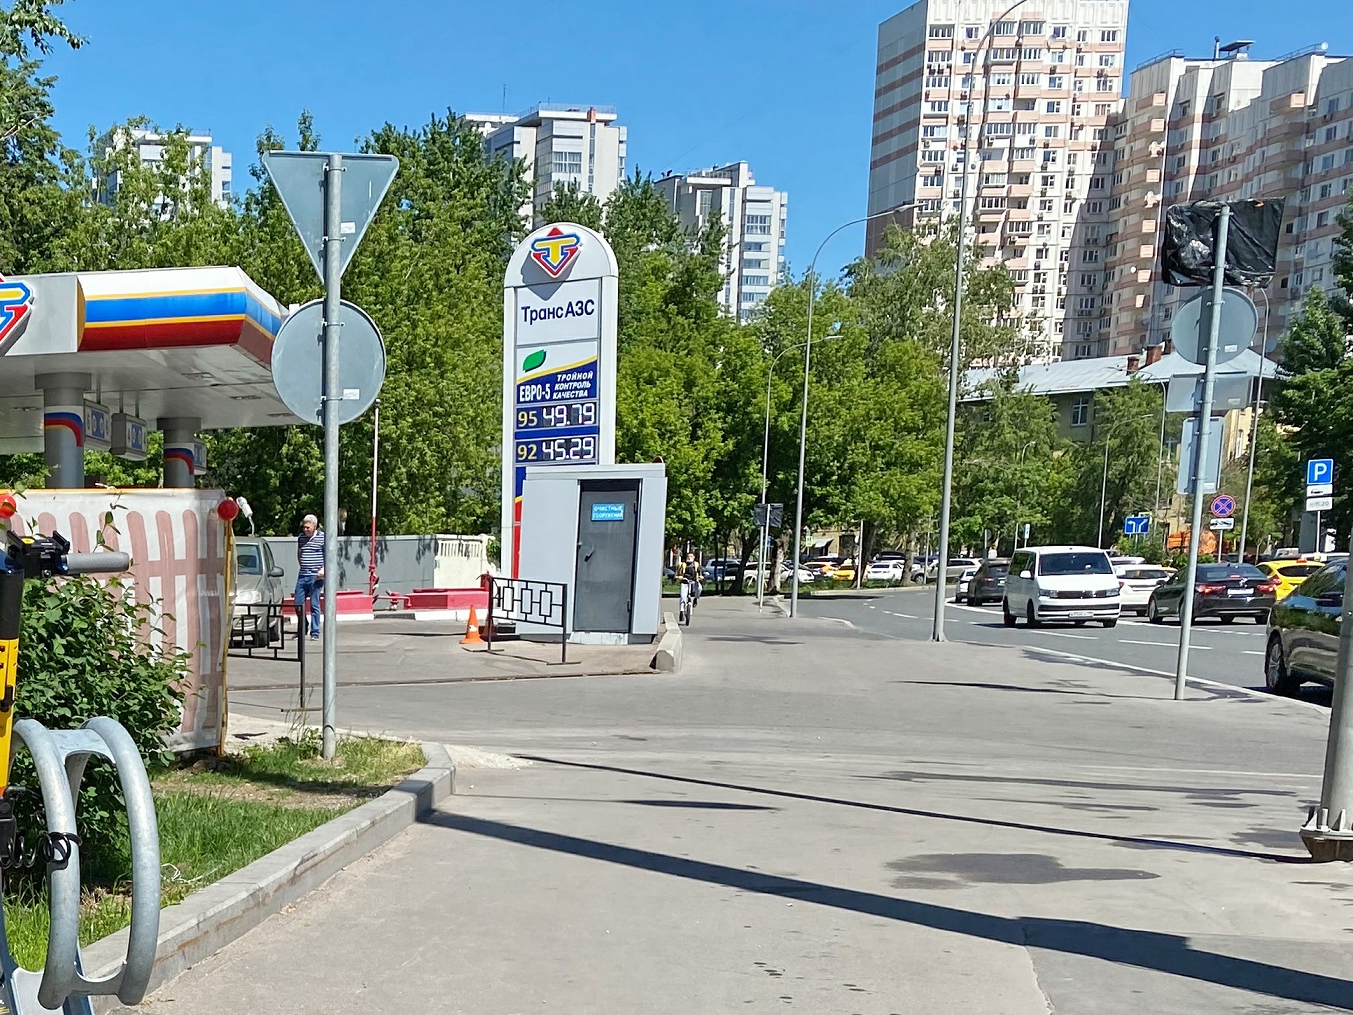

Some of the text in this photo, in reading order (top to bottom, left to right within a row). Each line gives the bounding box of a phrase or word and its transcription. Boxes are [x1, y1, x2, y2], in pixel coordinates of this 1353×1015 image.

[521, 299, 595, 325] ТрансАЗС
[557, 371, 593, 382] ТРОЙНОЙ
[519, 384, 551, 402] ЕВРО-5
[552, 390, 588, 400] КАЧЕСТВА
[554, 381, 591, 391] КОНТРОЛЬ
[518, 403, 595, 427] 95 49.79
[517, 438, 595, 460] 92 45.29
